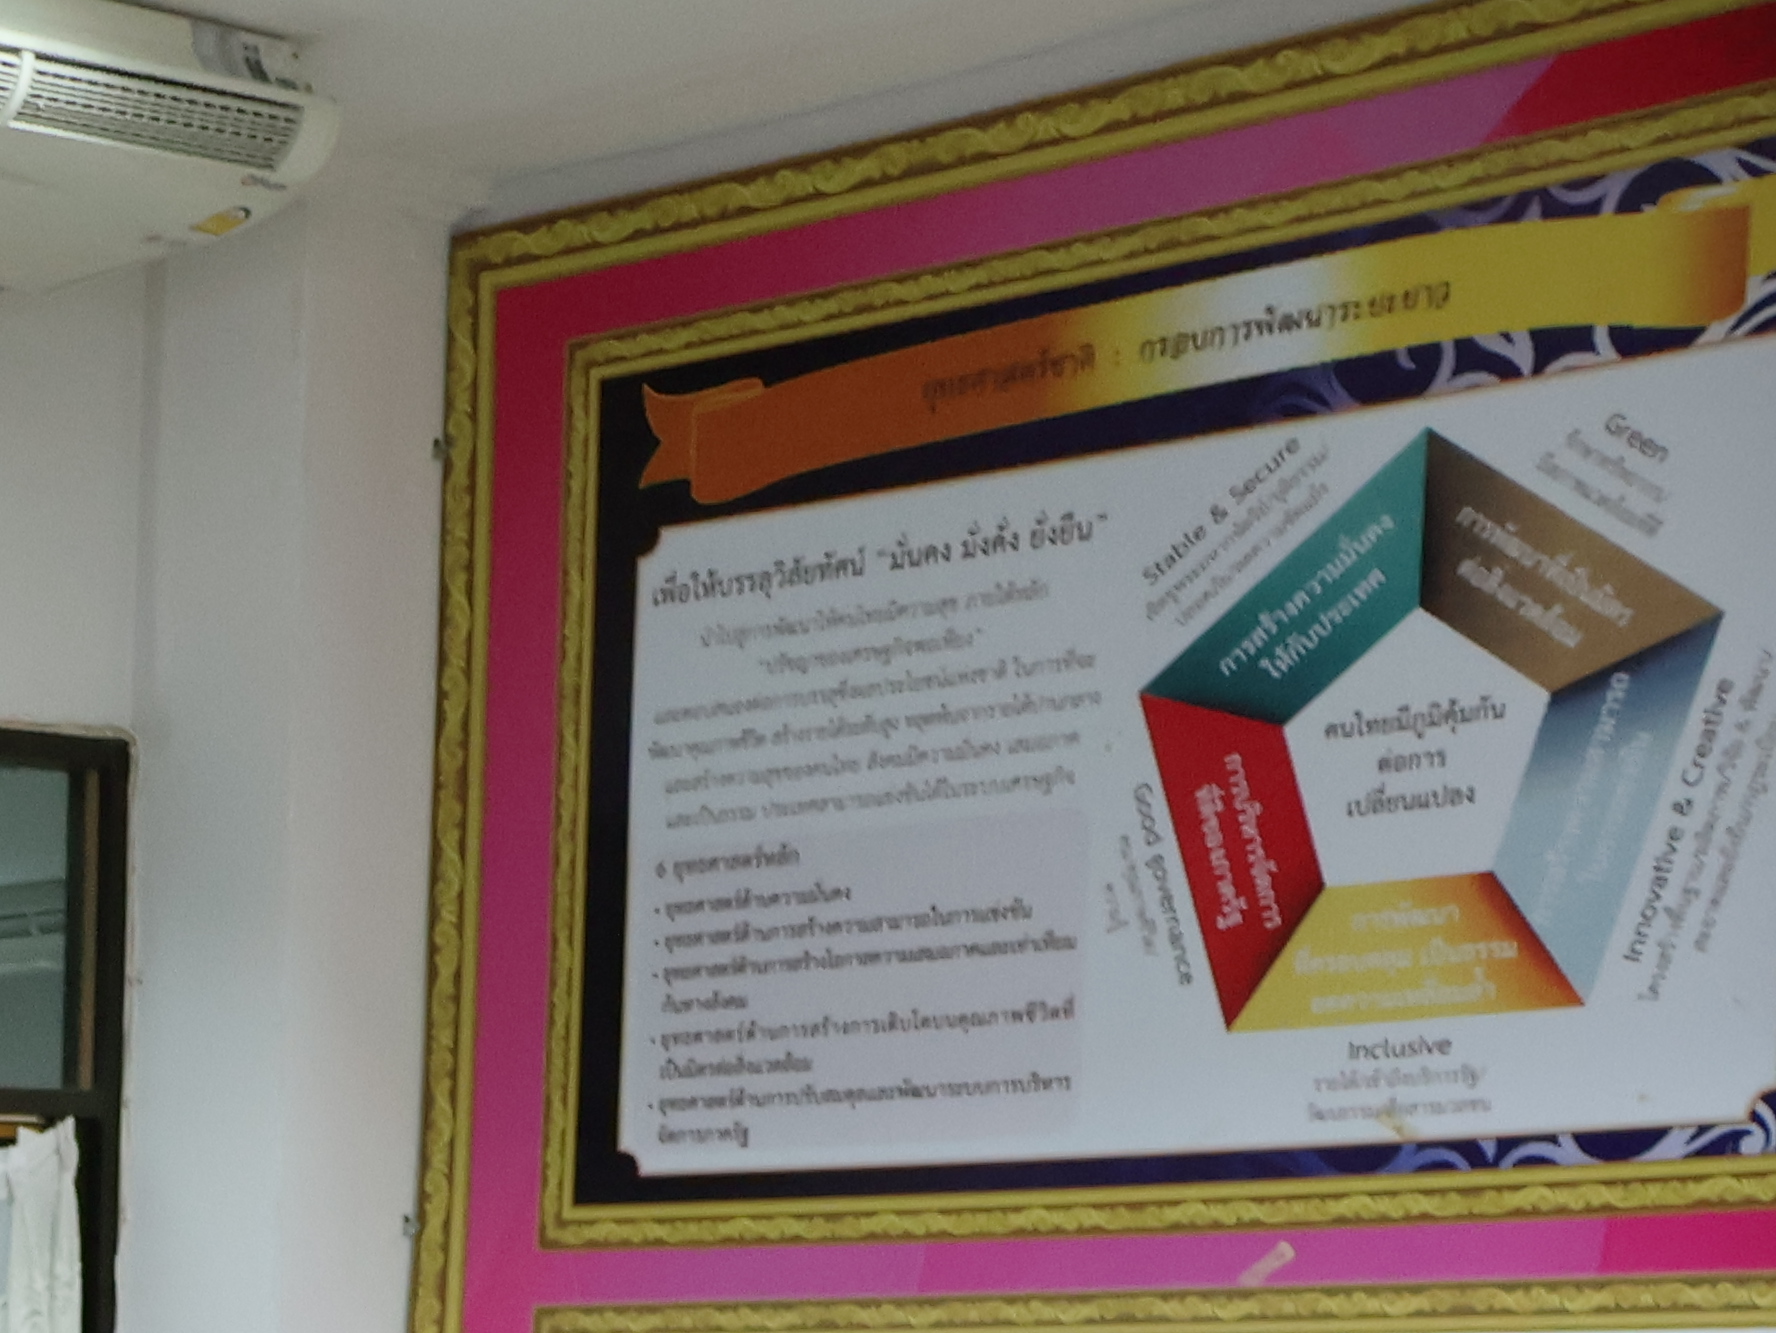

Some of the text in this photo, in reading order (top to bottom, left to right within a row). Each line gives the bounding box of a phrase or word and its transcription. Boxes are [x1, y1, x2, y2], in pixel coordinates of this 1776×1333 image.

[1605, 413, 1669, 464] Green
[1142, 524, 1207, 586] Stable
[1210, 503, 1229, 525] &
[1229, 437, 1301, 506] Secure
[1133, 782, 1164, 847] Good
[1622, 826, 1685, 963] Innovative
[1681, 677, 1735, 788] Creative
[1145, 854, 1193, 986] governance
[1348, 1034, 1454, 1062] Inclusive
